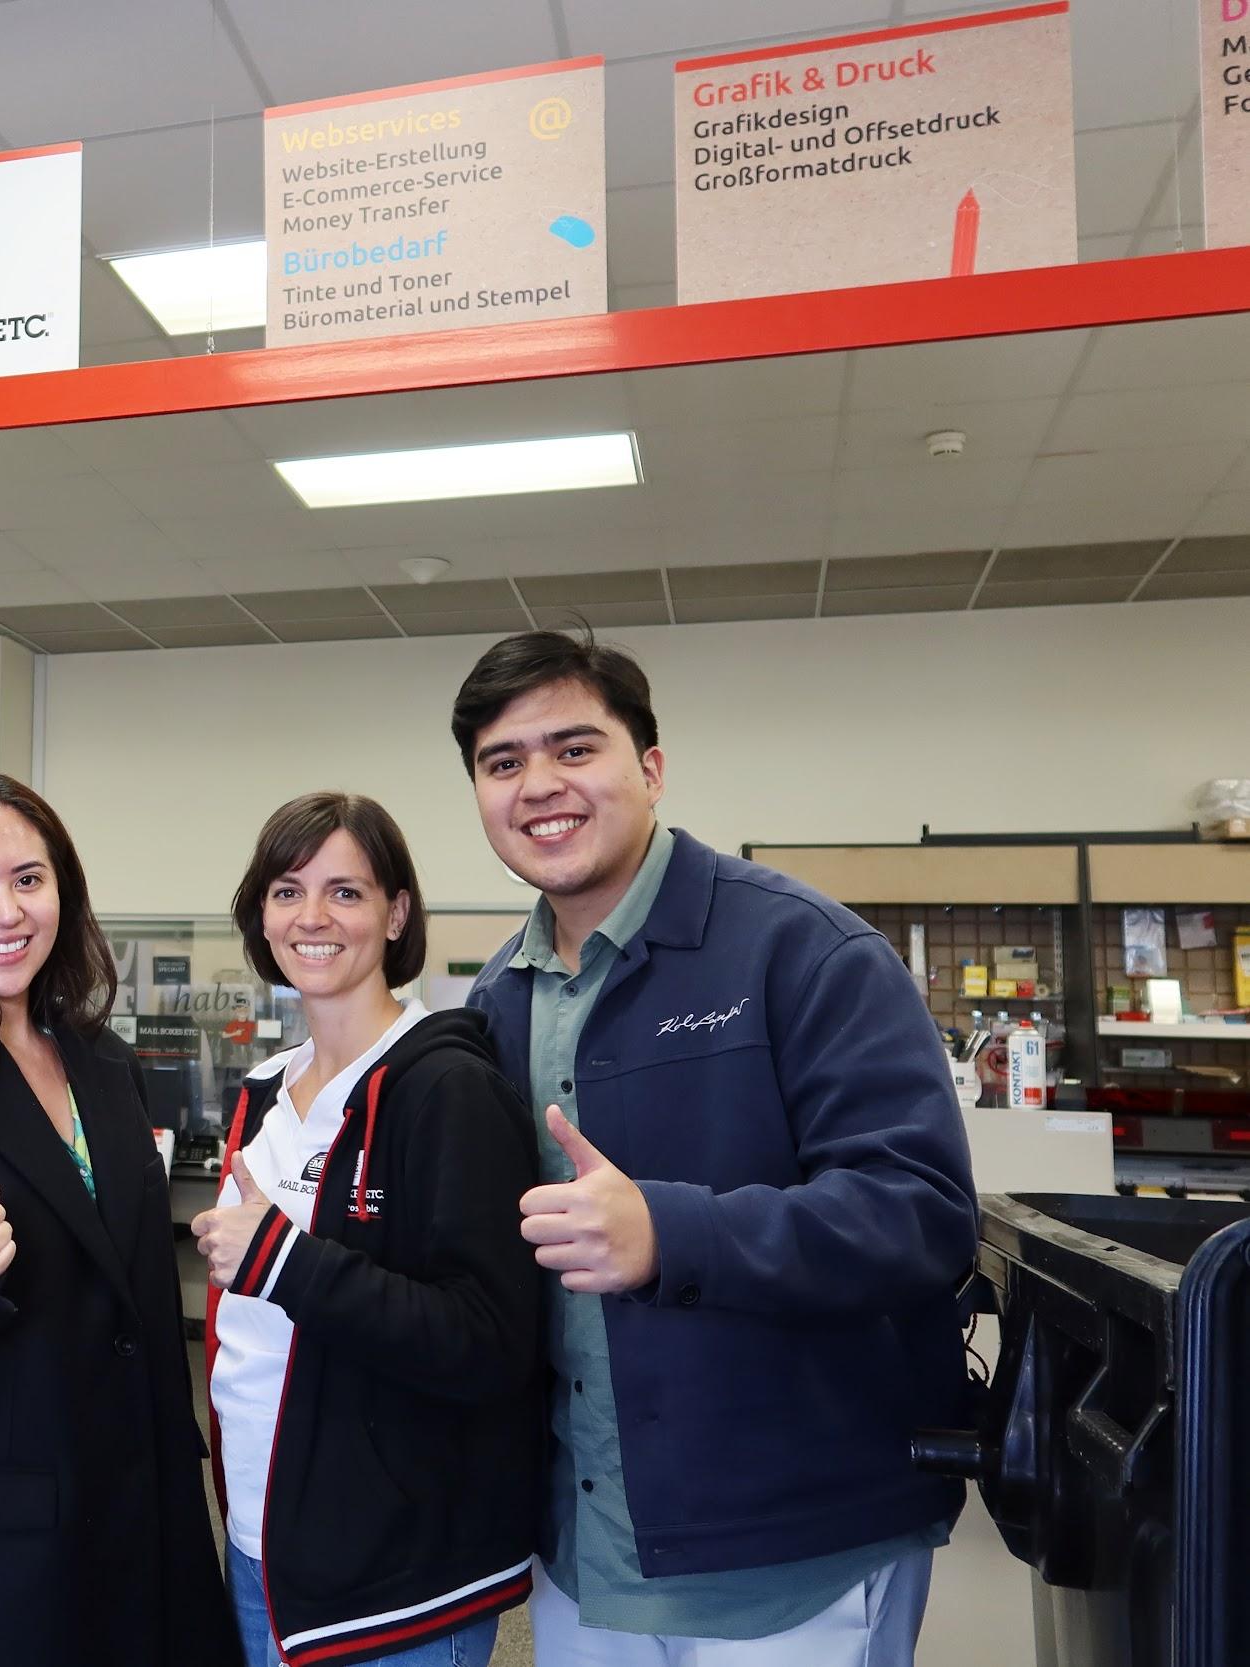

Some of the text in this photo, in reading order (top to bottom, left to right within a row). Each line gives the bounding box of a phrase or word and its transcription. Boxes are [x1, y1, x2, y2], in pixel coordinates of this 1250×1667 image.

[1222, 35, 1250, 57] M
[694, 49, 937, 108] Grafik & Druck
[281, 108, 462, 153] Webservices
[694, 104, 849, 139] Grafikdesign
[694, 106, 1001, 166] Digital- und Offsetdruck
[282, 141, 488, 184] Website-Erstellung
[694, 146, 912, 192] Großformatdruck
[283, 164, 503, 210] E-Commerce-Service
[283, 197, 450, 234] Money Transfer
[284, 230, 448, 276] Bürobedarf
[283, 272, 453, 306] Tinte und Toner
[284, 280, 571, 330] Büromaterial und Stempel
[1026, 1040, 1039, 1056] 61
[1012, 1051, 1022, 1105] KONTAKT
[278, 1179, 299, 1192] MAIL
[347, 1204, 379, 1213] osble
